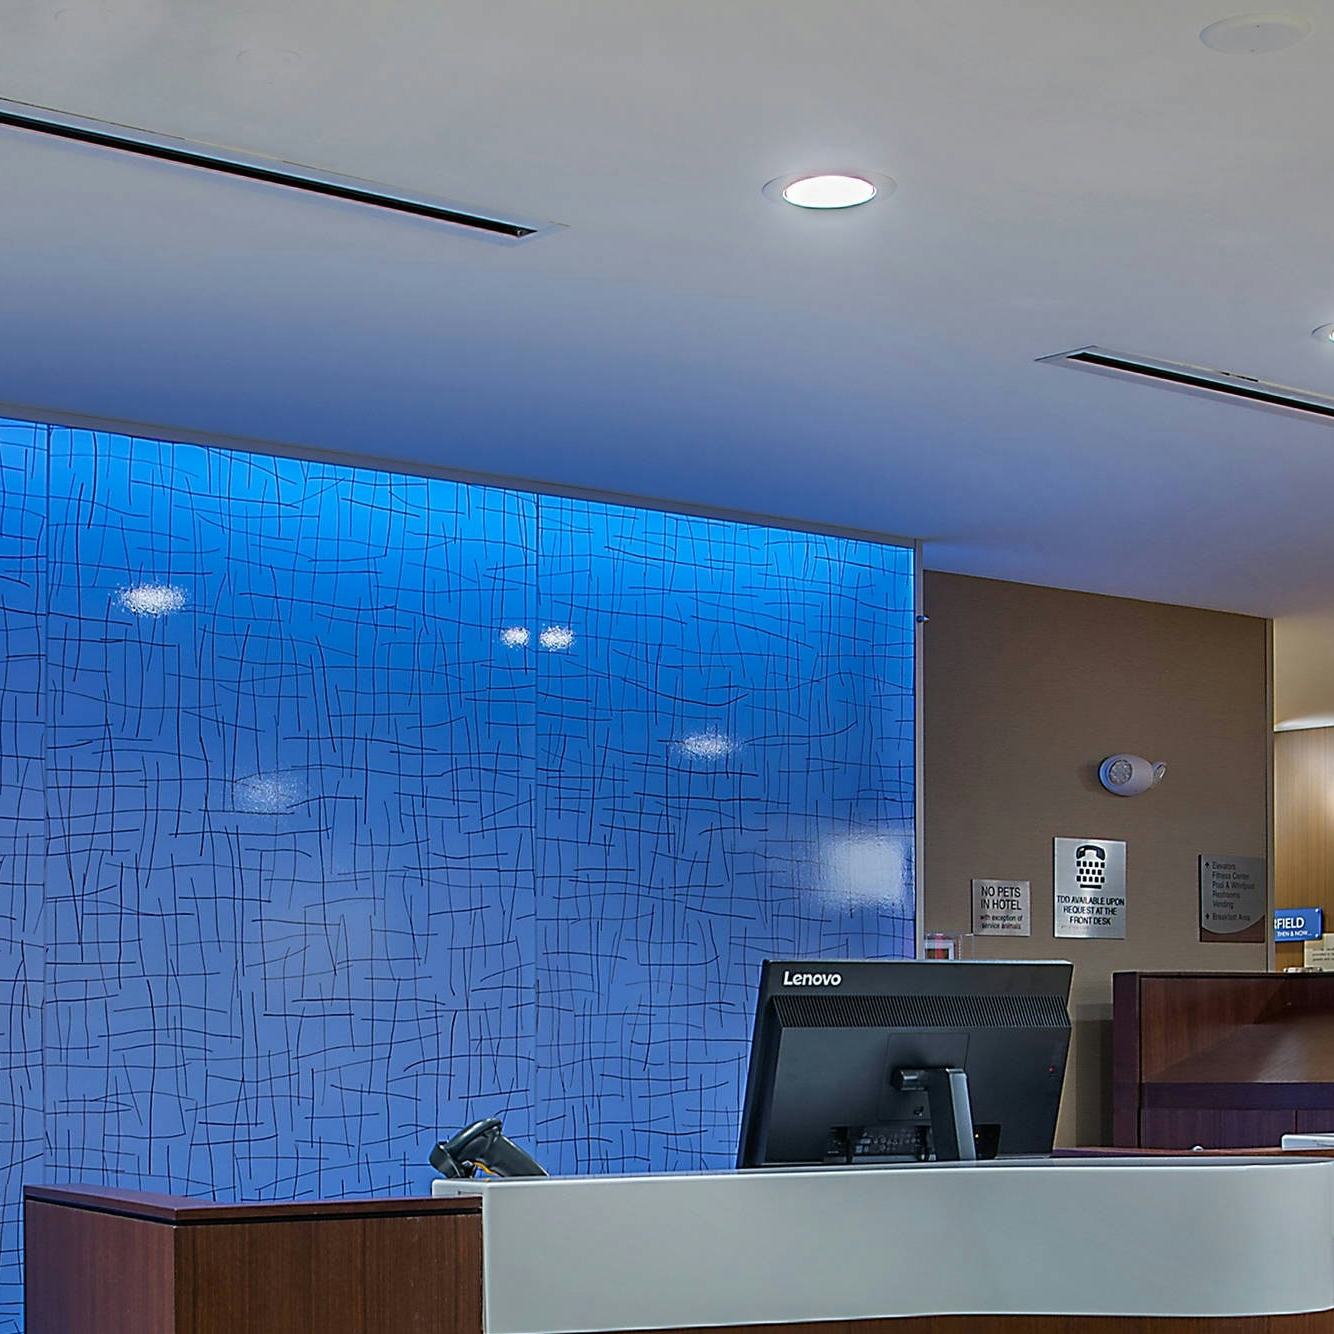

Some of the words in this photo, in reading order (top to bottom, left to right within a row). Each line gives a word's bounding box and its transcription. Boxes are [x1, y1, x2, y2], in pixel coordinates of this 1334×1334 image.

[1212, 871, 1231, 879] Fitness
[1232, 872, 1250, 880] Center
[981, 886, 995, 897] NO
[997, 886, 1021, 898] PETS
[980, 898, 990, 909] IN
[992, 899, 1022, 910] HOTEL
[1071, 896, 1105, 905] AVAILABLE
[1106, 897, 1125, 906] UPON
[1063, 905, 1094, 914] REQUEST
[1095, 906, 1104, 915] AT
[1104, 907, 1118, 915] THE
[1069, 915, 1093, 924] FRONT
[1093, 917, 1112, 925] DESK
[783, 971, 842, 986] Lenovo
